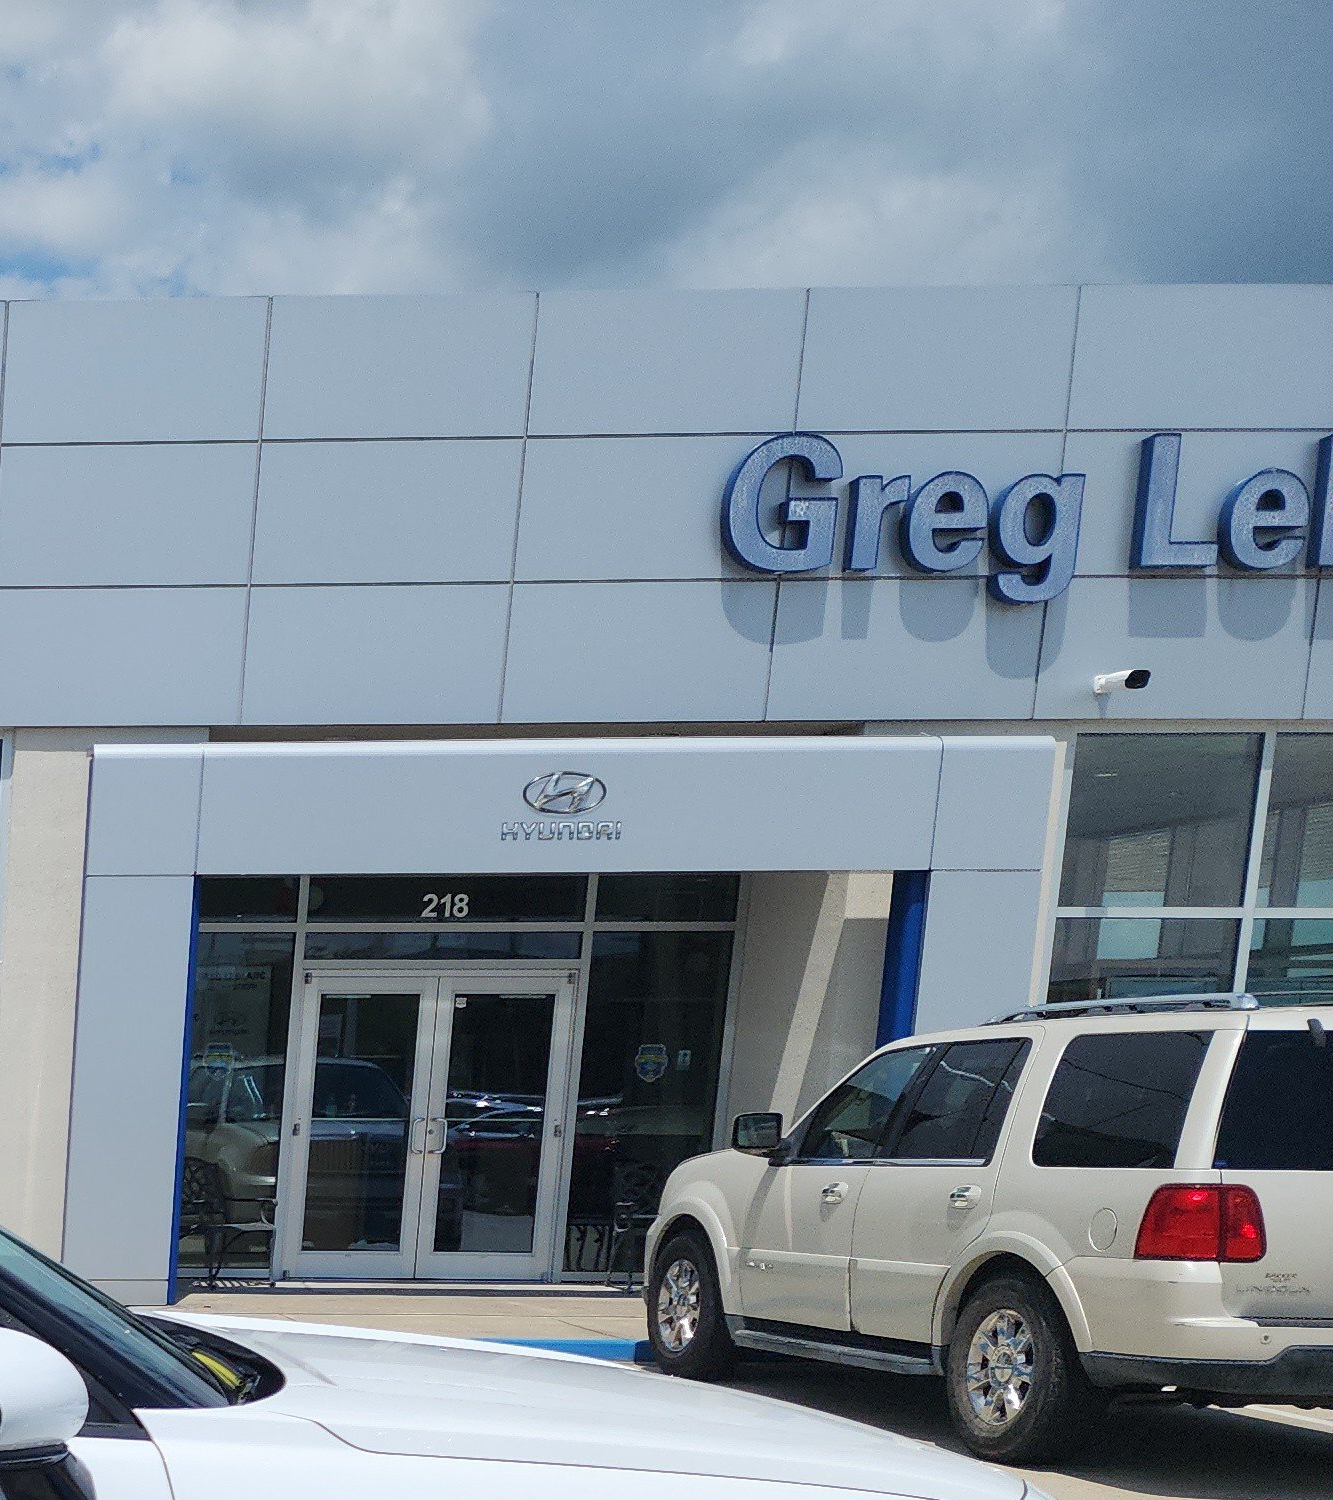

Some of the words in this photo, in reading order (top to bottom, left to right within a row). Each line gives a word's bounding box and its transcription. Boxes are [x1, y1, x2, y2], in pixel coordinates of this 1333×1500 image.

[721, 432, 1086, 604] Greg
[1129, 432, 1333, 573] Le
[501, 821, 622, 841] HYUNDAI
[420, 893, 469, 918] 218
